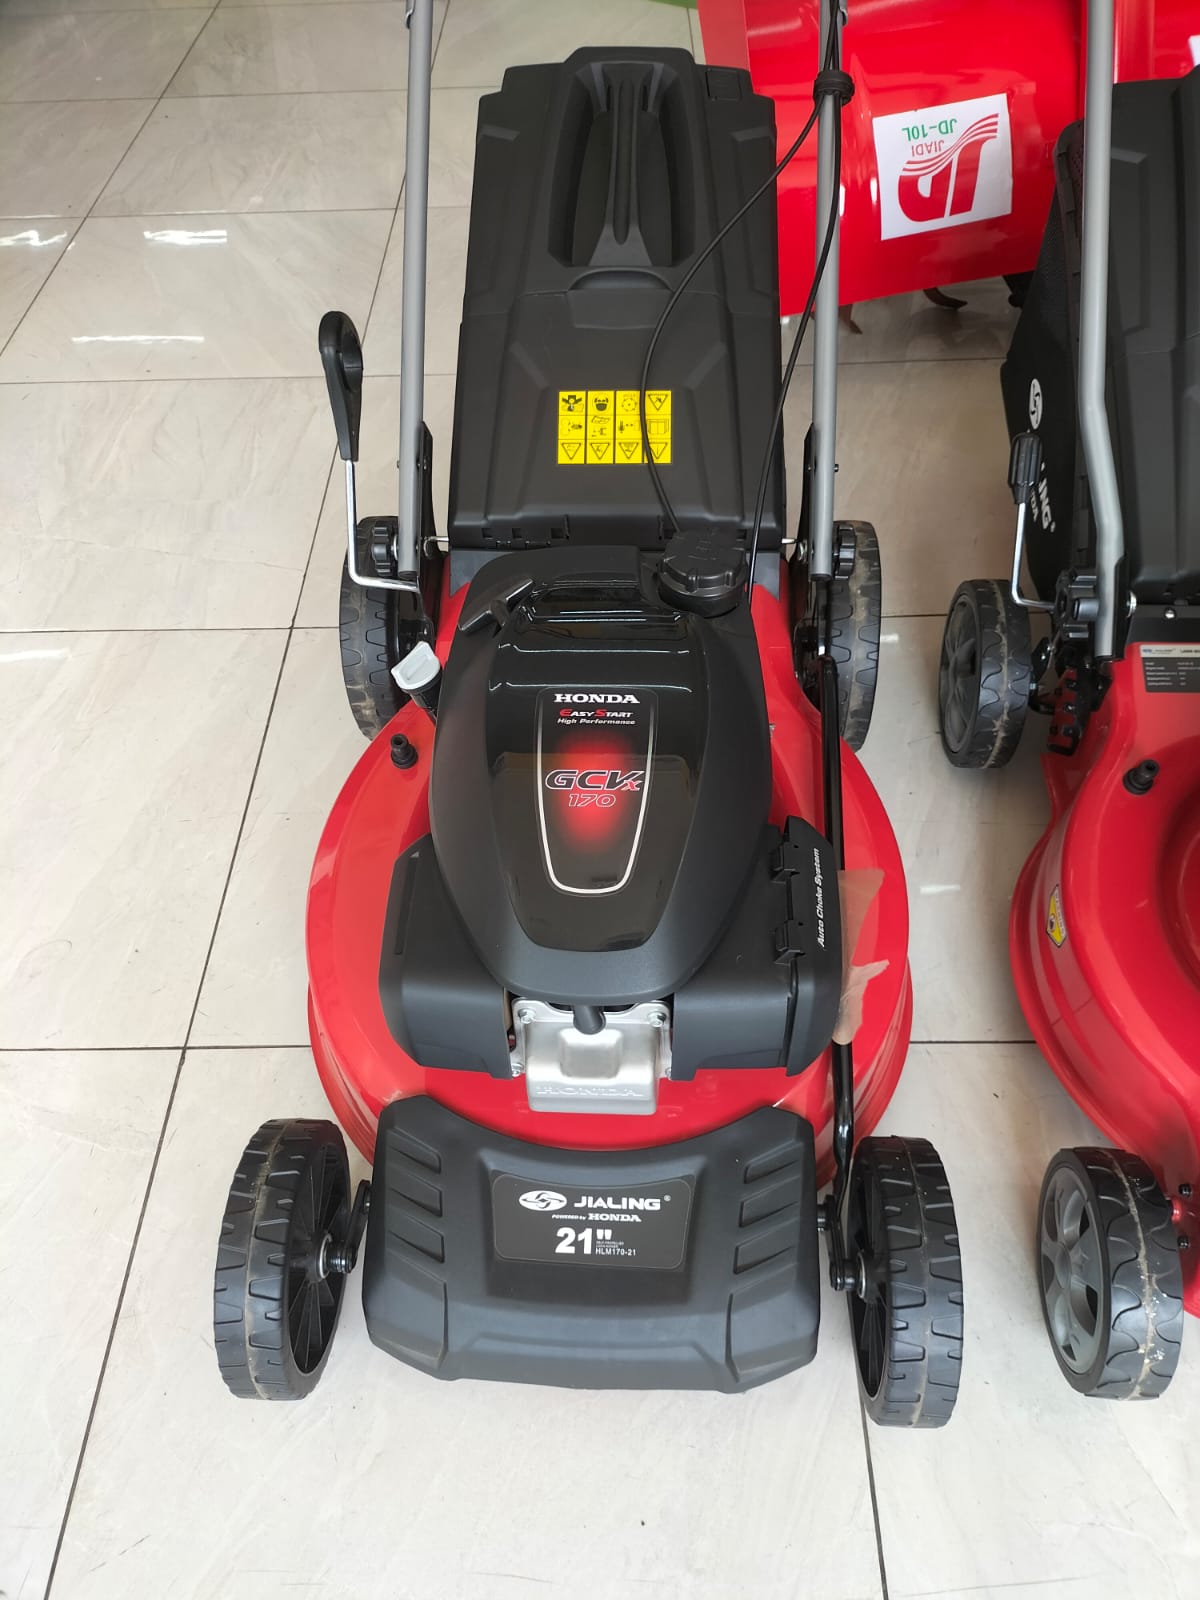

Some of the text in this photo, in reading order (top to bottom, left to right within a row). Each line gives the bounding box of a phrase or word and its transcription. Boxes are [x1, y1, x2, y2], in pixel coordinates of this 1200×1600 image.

[902, 118, 957, 142] JD-10L
[911, 140, 945, 157] JIADI
[554, 693, 640, 704] HONDA
[569, 793, 616, 807] 170
[813, 847, 825, 948] Auto Choke System
[535, 1086, 644, 1097] HONDA
[574, 1196, 661, 1211] JIALING
[588, 1212, 642, 1222] HONDA
